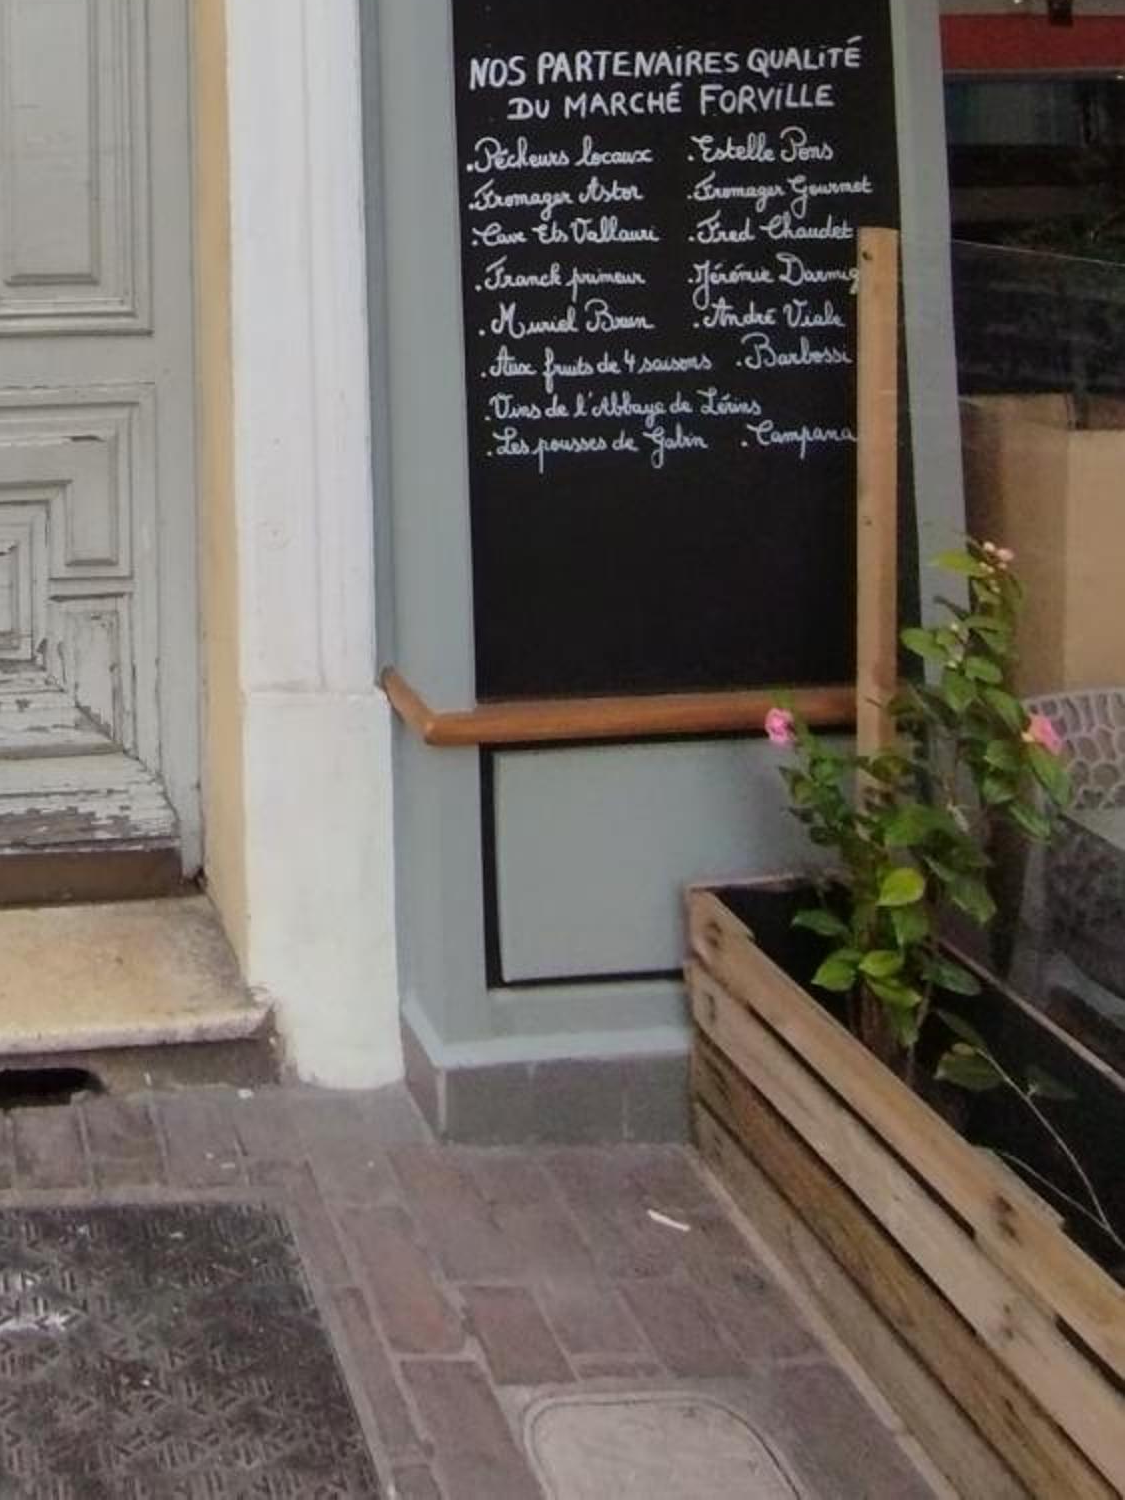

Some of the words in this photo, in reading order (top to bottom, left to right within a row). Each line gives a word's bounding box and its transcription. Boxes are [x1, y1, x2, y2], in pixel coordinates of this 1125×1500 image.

[469, 54, 527, 91] NOS
[507, 97, 550, 120] DU
[564, 82, 683, 118] MARCHÉ
[575, 135, 655, 167] locaux
[691, 132, 776, 162] Estelle
[779, 126, 834, 163] Pons
[475, 178, 575, 222] Fromager
[578, 176, 645, 203] Astor
[693, 171, 787, 213] Fromager
[787, 174, 874, 220] Gourmet
[472, 222, 528, 247] Cave
[531, 221, 570, 244] Ets
[570, 215, 660, 244] Vallauri
[696, 210, 756, 244] Fred
[759, 210, 854, 240] Chaudet
[485, 255, 564, 290] Franck
[565, 267, 647, 301] primeur
[692, 259, 775, 311] Jérémie
[776, 252, 859, 295] Darmig
[491, 302, 579, 339] Muriel
[584, 298, 656, 332] Brun
[703, 297, 776, 328] André
[783, 299, 846, 328] Viale
[489, 344, 538, 377] Aux
[542, 347, 595, 394] fruits
[597, 352, 621, 375] de
[624, 348, 636, 373] 4
[637, 354, 713, 375] saisons
[740, 332, 853, 370] Barbossi
[489, 392, 541, 420] Vins
[545, 394, 570, 418] de
[669, 391, 694, 414] de
[696, 386, 763, 417] Lérins
[492, 427, 530, 455] Les
[532, 435, 609, 475] pousses
[611, 430, 640, 452] de
